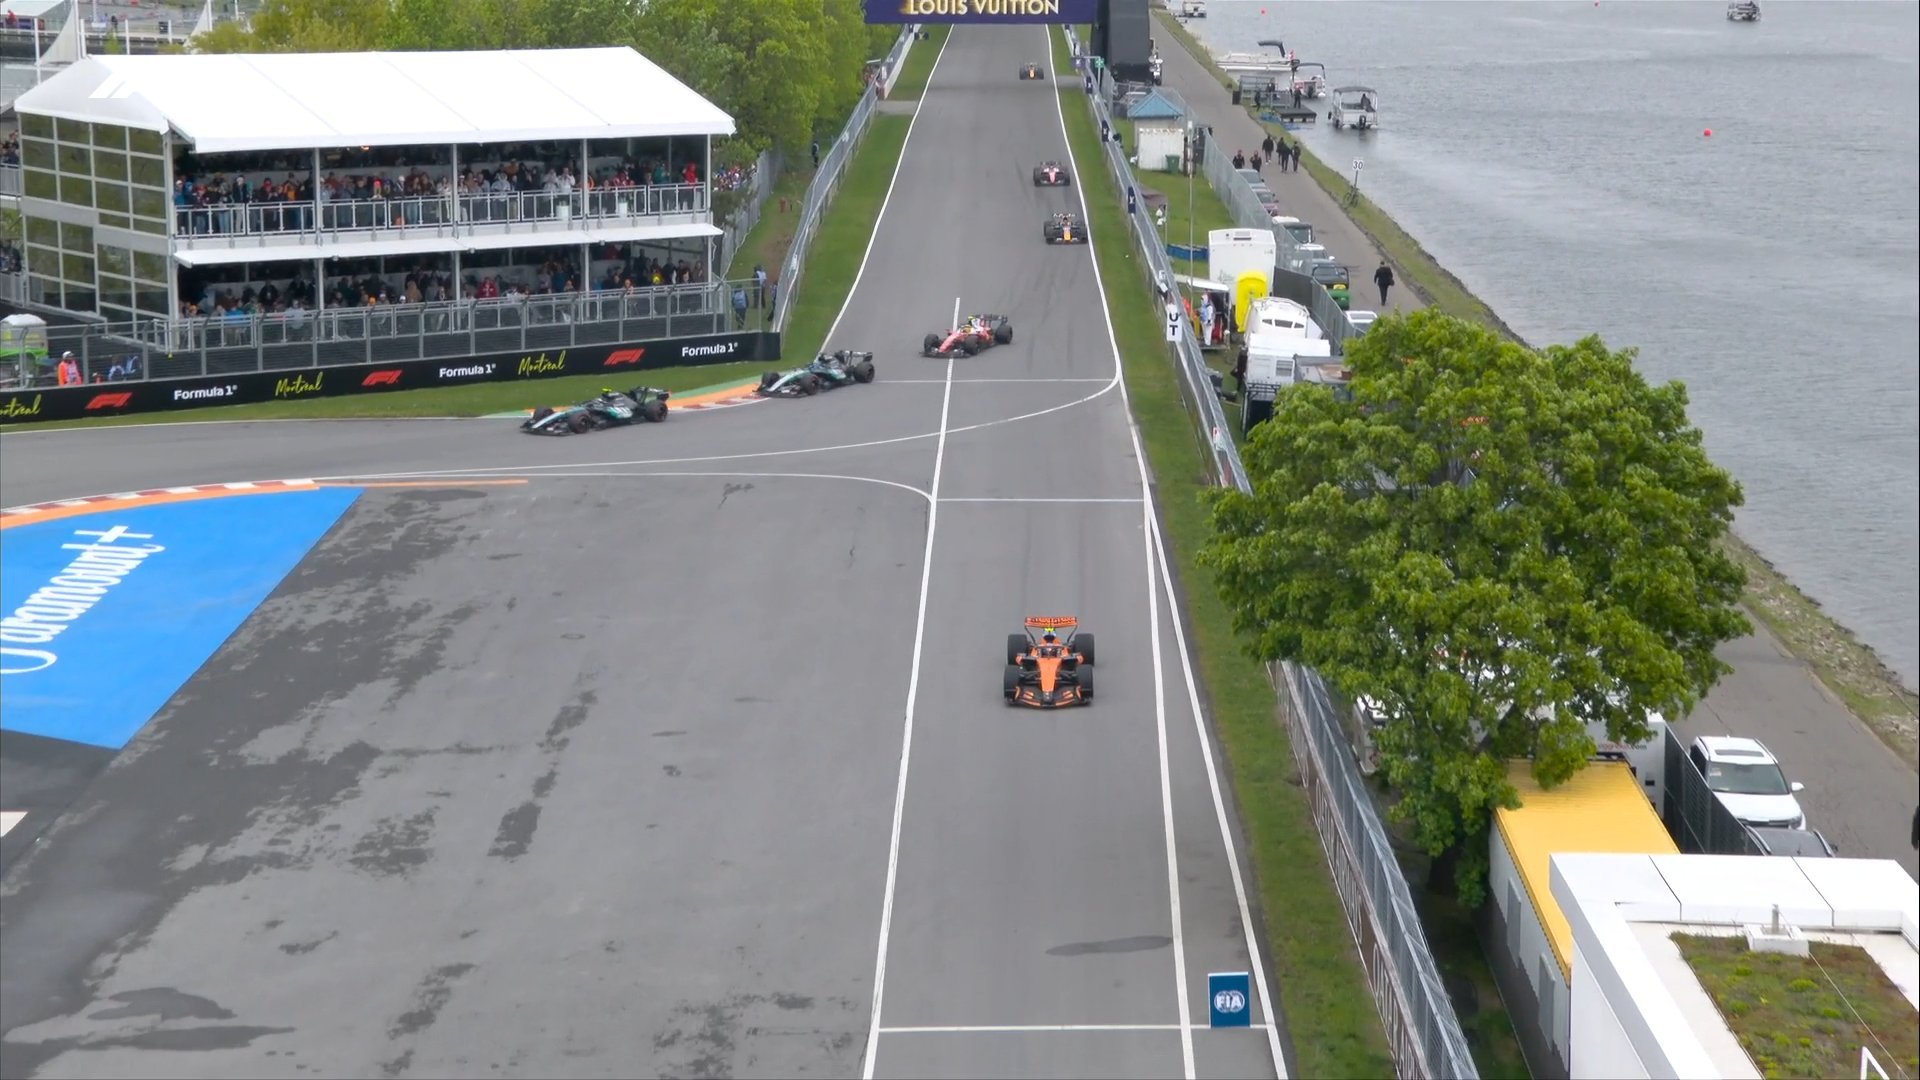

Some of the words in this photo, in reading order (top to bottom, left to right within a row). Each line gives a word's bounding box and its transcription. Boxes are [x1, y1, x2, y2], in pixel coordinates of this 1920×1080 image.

[910, 0, 968, 15] LOUIS
[974, 0, 1059, 15] VUITTON
[1352, 161, 1364, 170] 30
[681, 343, 726, 357] Formula
[439, 365, 485, 378] Formula
[173, 386, 225, 401] Formula
[1216, 995, 1242, 1008] FIA
